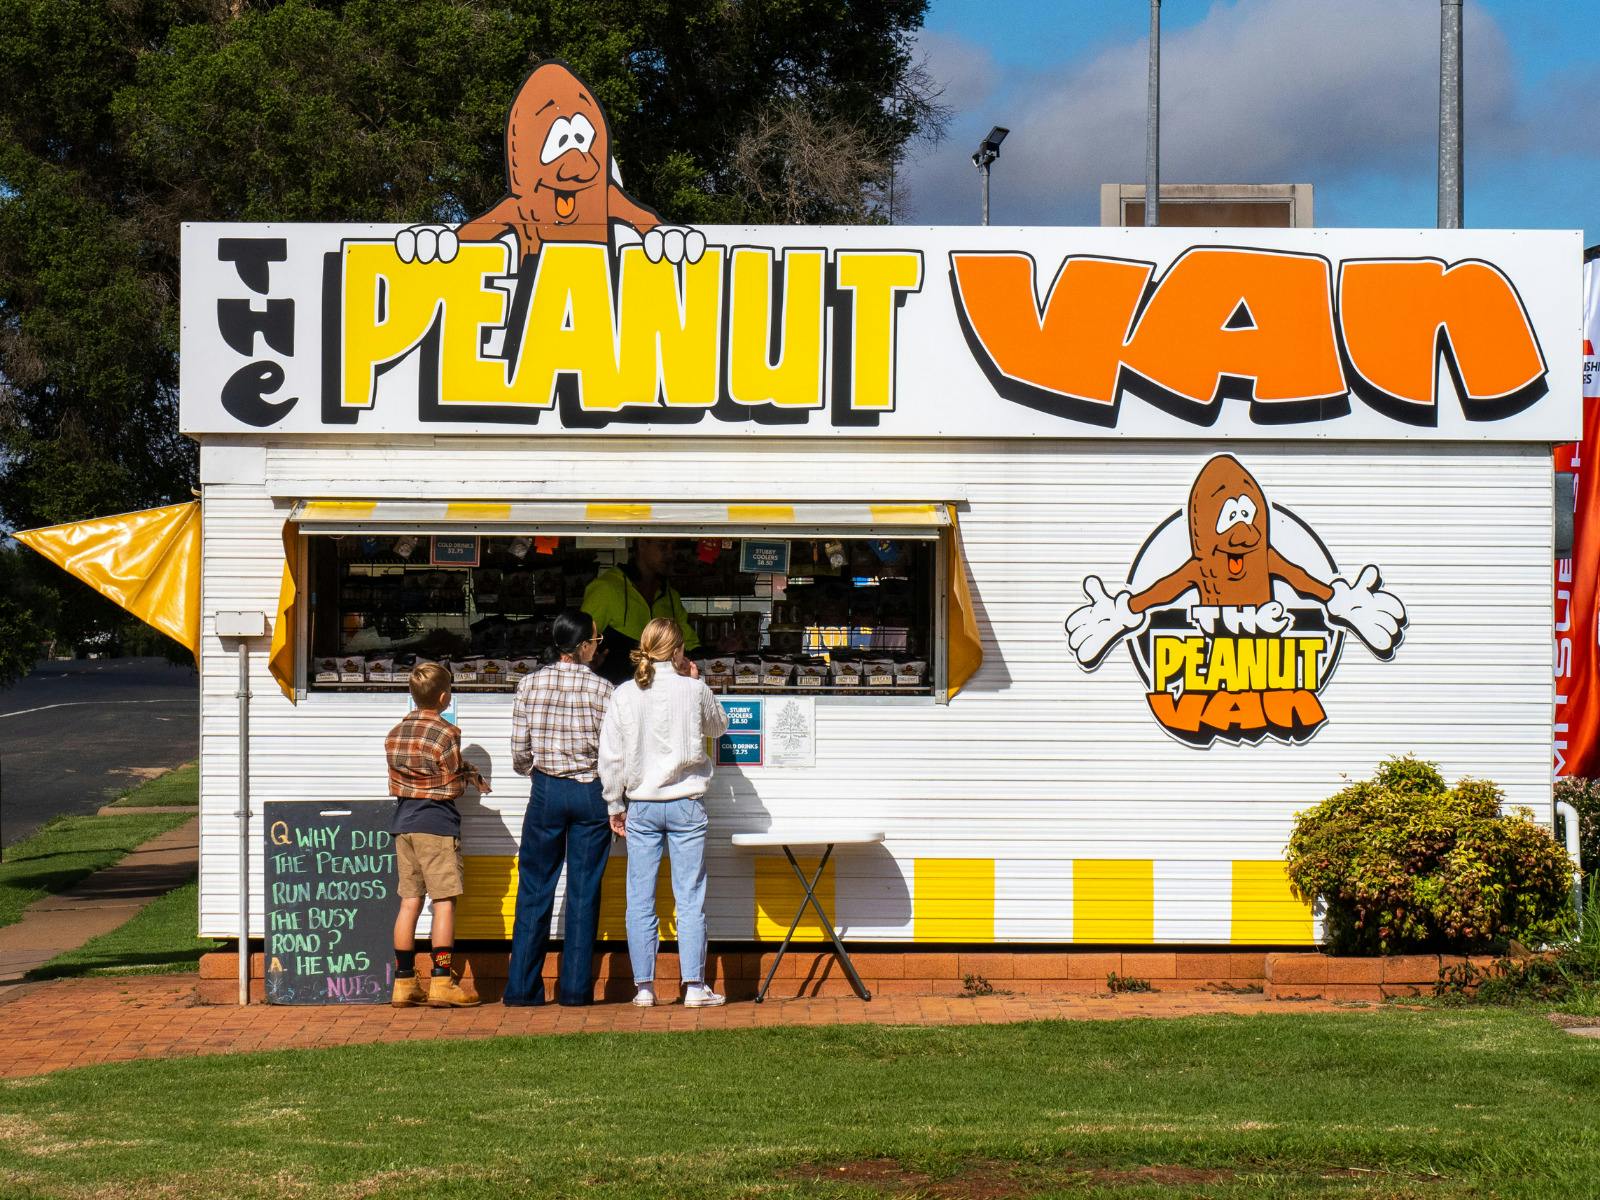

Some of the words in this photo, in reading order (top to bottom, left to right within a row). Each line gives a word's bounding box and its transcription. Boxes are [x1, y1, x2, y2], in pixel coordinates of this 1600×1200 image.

[326, 239, 924, 422] PEANUT
[1154, 635, 1325, 692] PEANUT
[295, 825, 340, 850] WHY
[351, 830, 390, 850] DID
[269, 853, 307, 875] THE
[316, 852, 398, 875] PEANUT
[272, 882, 311, 905] RUN
[316, 879, 387, 901] ACROSS
[266, 909, 302, 931] THE
[308, 907, 358, 930] BUSY
[268, 957, 287, 972] A
[296, 956, 323, 976] HE
[327, 952, 370, 974] WAS
